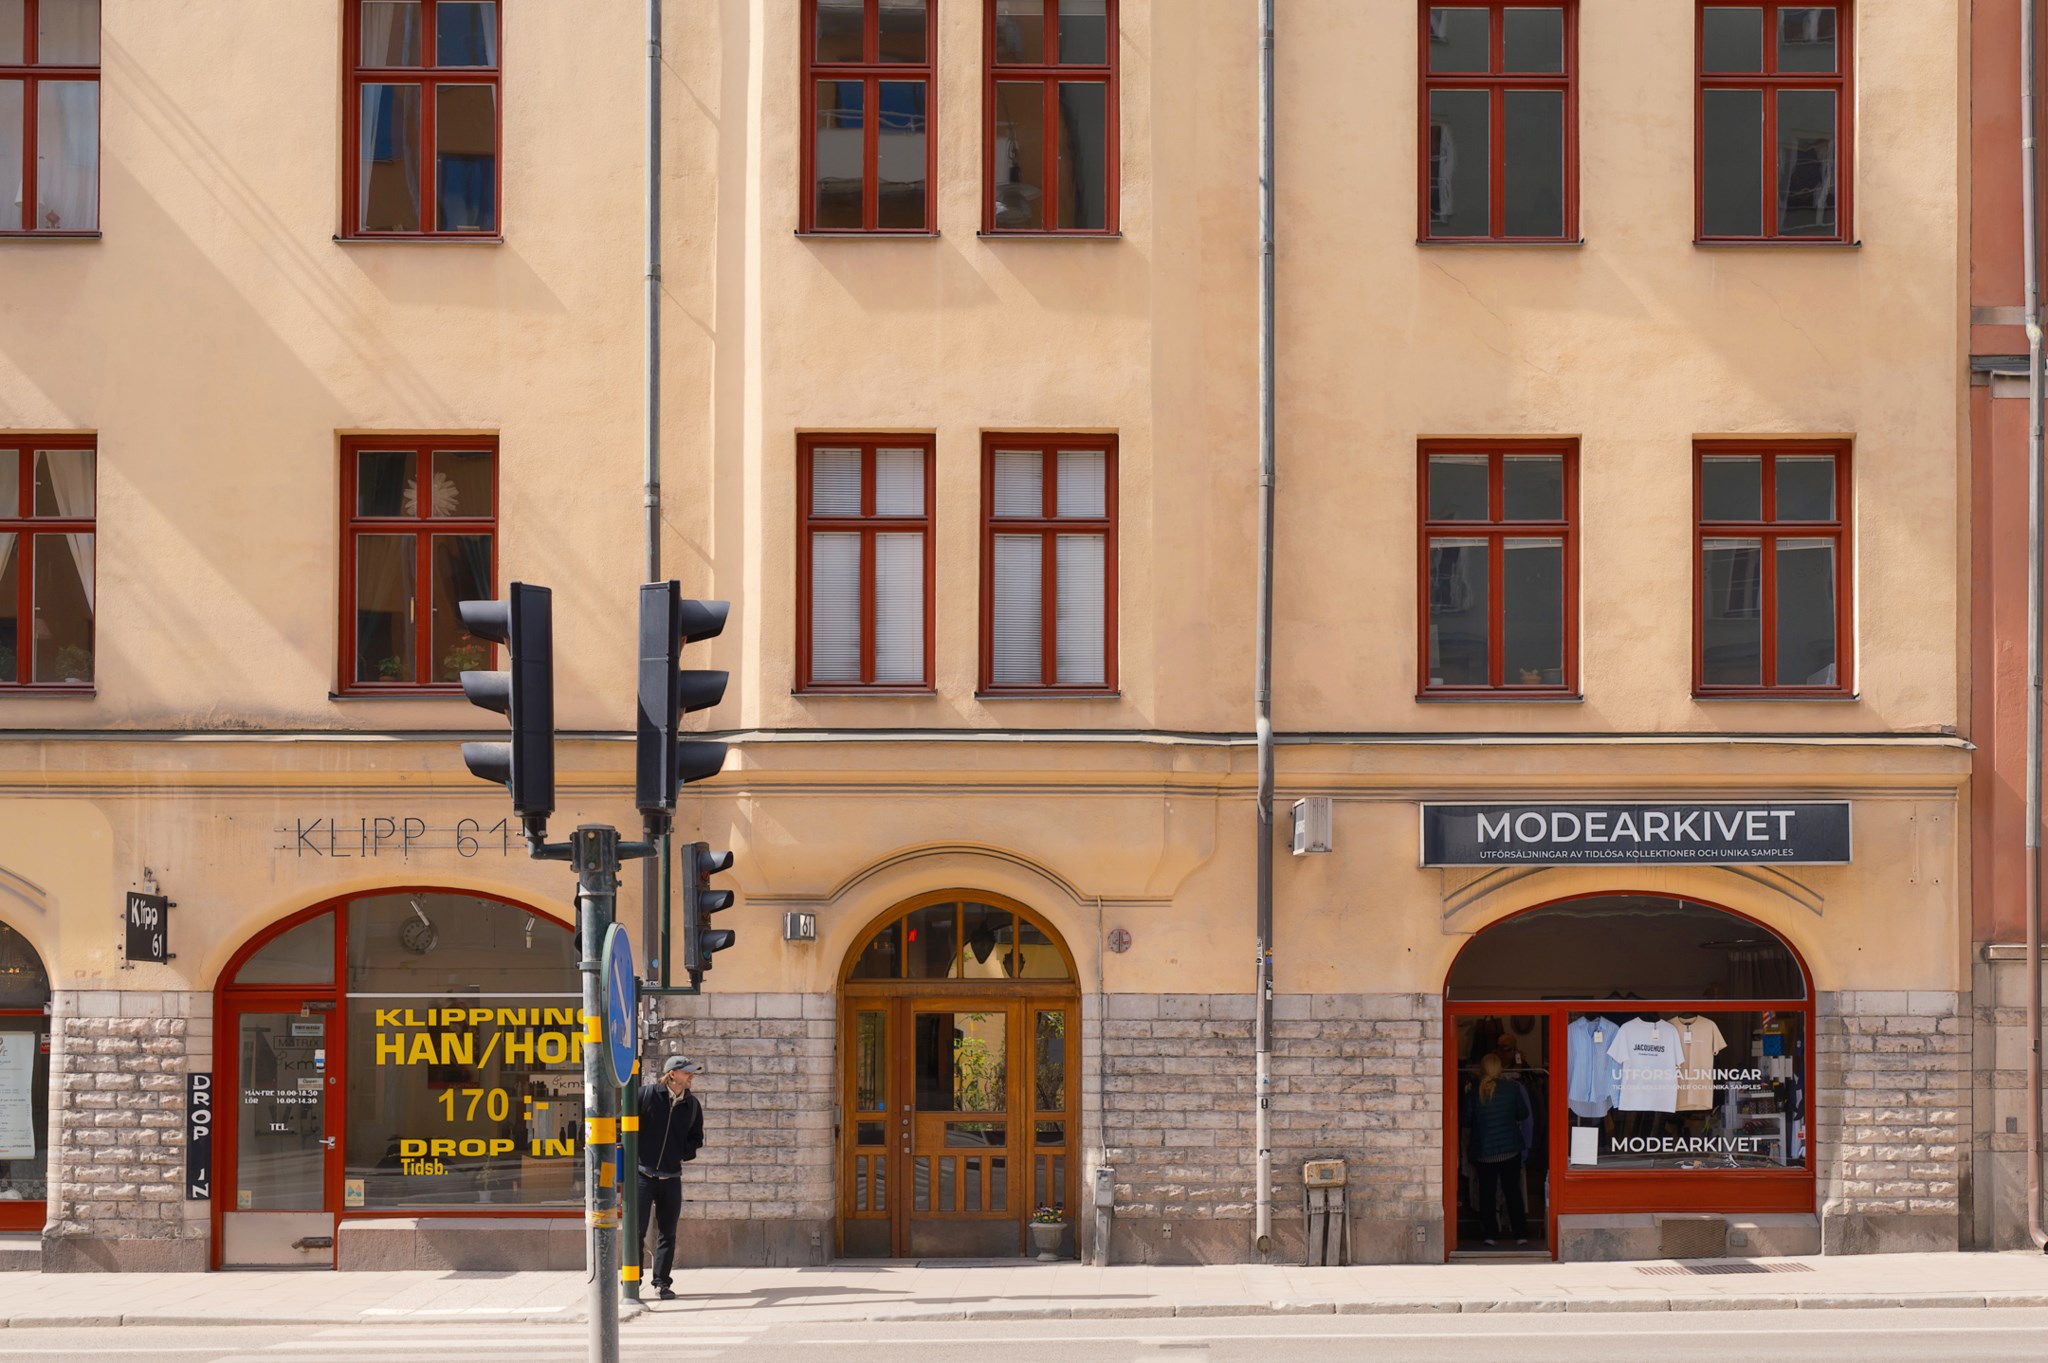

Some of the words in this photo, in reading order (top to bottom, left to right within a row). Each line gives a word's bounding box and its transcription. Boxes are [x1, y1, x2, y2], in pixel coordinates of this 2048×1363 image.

[1476, 810, 1796, 843] MODEARKIVET
[297, 818, 426, 857] KLIPP
[457, 818, 507, 857] 61
[1480, 849, 1568, 859] UTFÖRSÄLJNINGAR
[1569, 850, 1583, 858] AV
[1585, 848, 1625, 858] TIDLÖSA
[1626, 849, 1696, 858] KOLLEKTIONER
[1697, 848, 1719, 857] OCH
[1720, 848, 1749, 857] UNIKA
[1751, 848, 1794, 857] SAMPLES
[131, 897, 158, 931] Klipp
[803, 915, 811, 936] 61
[152, 933, 163, 958] 61
[285, 1060, 315, 1070] km
[1612, 1065, 1762, 1081] UTFÖRSÄLJNINGAR
[277, 1089, 318, 1097] 10.00-18.30
[191, 1075, 211, 1141] DROP
[438, 1088, 509, 1122] 170
[523, 1095, 549, 1121] :-
[400, 1138, 515, 1157] DROP
[531, 1138, 575, 1157] IN
[1611, 1137, 1762, 1152] MODEARKIVET
[401, 1158, 449, 1176] Tidsb.
[192, 1168, 209, 1198] IN
